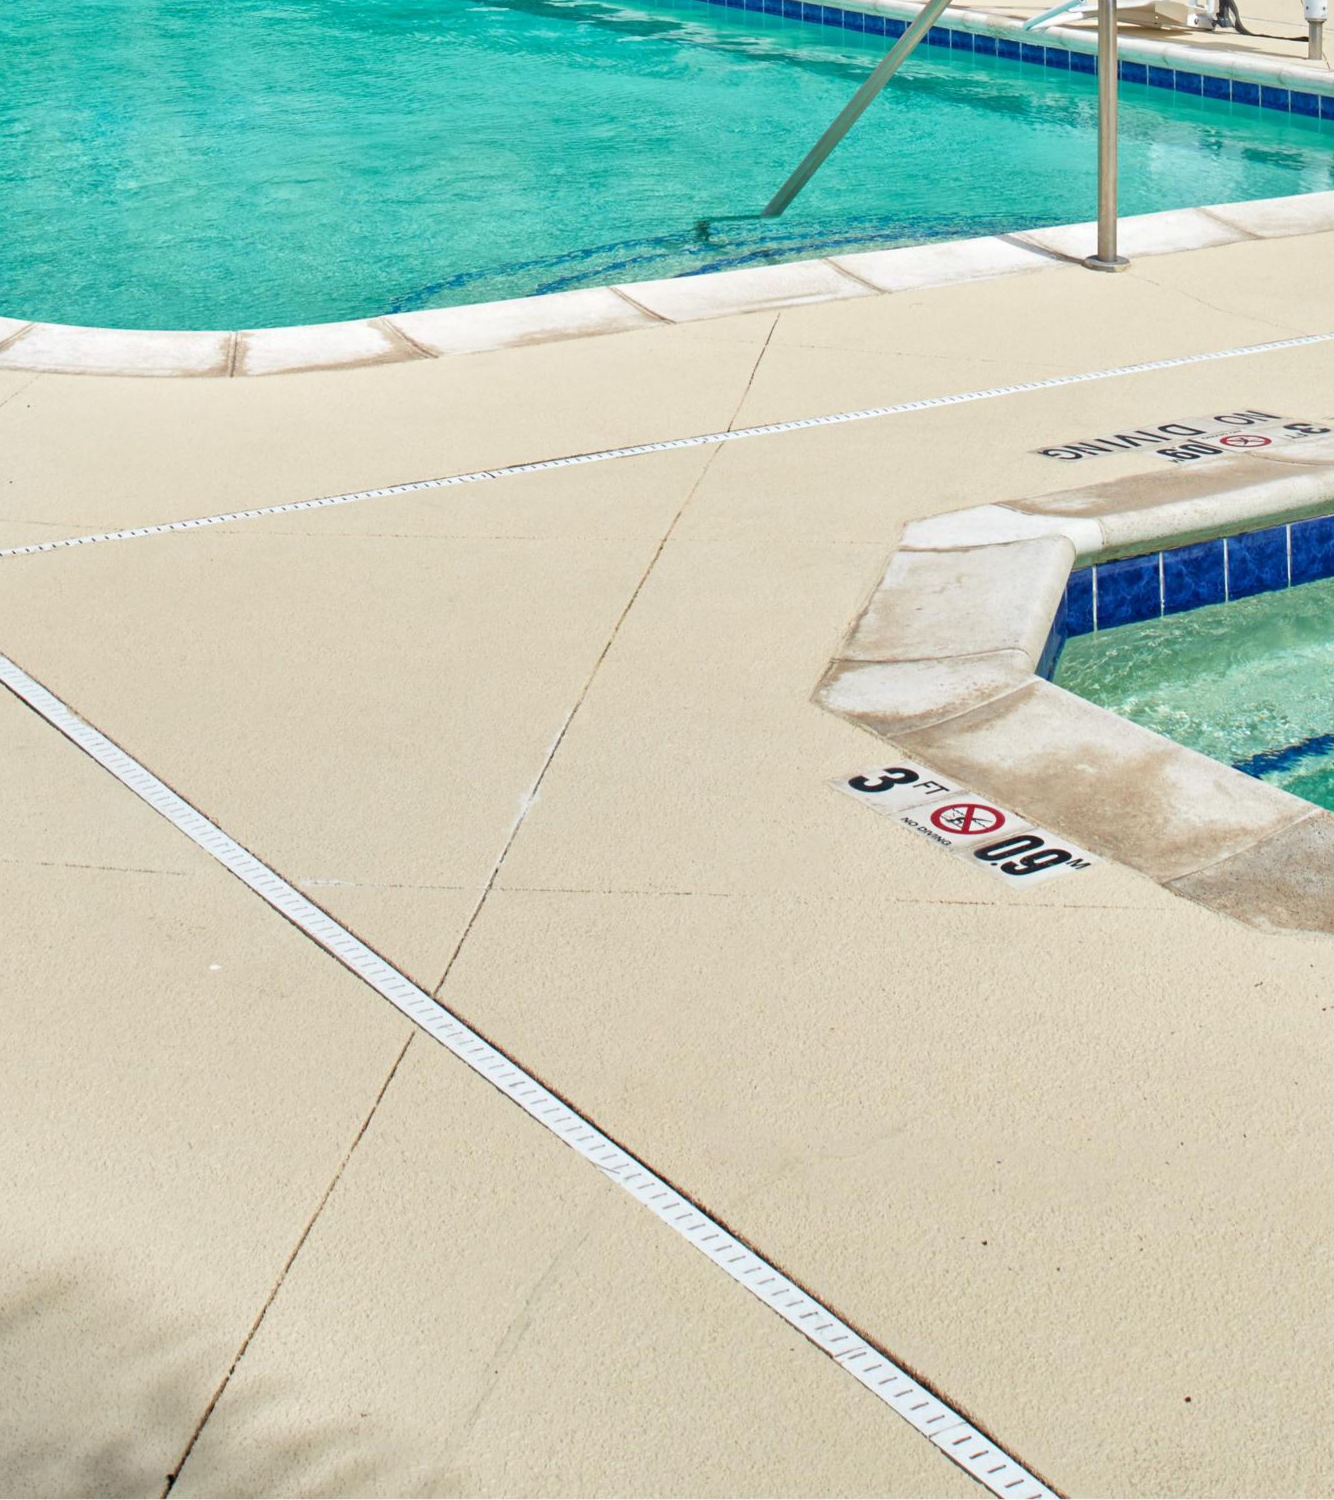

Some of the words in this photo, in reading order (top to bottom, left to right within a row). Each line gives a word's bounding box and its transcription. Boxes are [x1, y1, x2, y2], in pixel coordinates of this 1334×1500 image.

[1213, 410, 1283, 425] NO
[1038, 423, 1207, 461] DIVING
[848, 767, 920, 793] 3
[912, 780, 950, 795] FT
[1066, 858, 1091, 870] M
